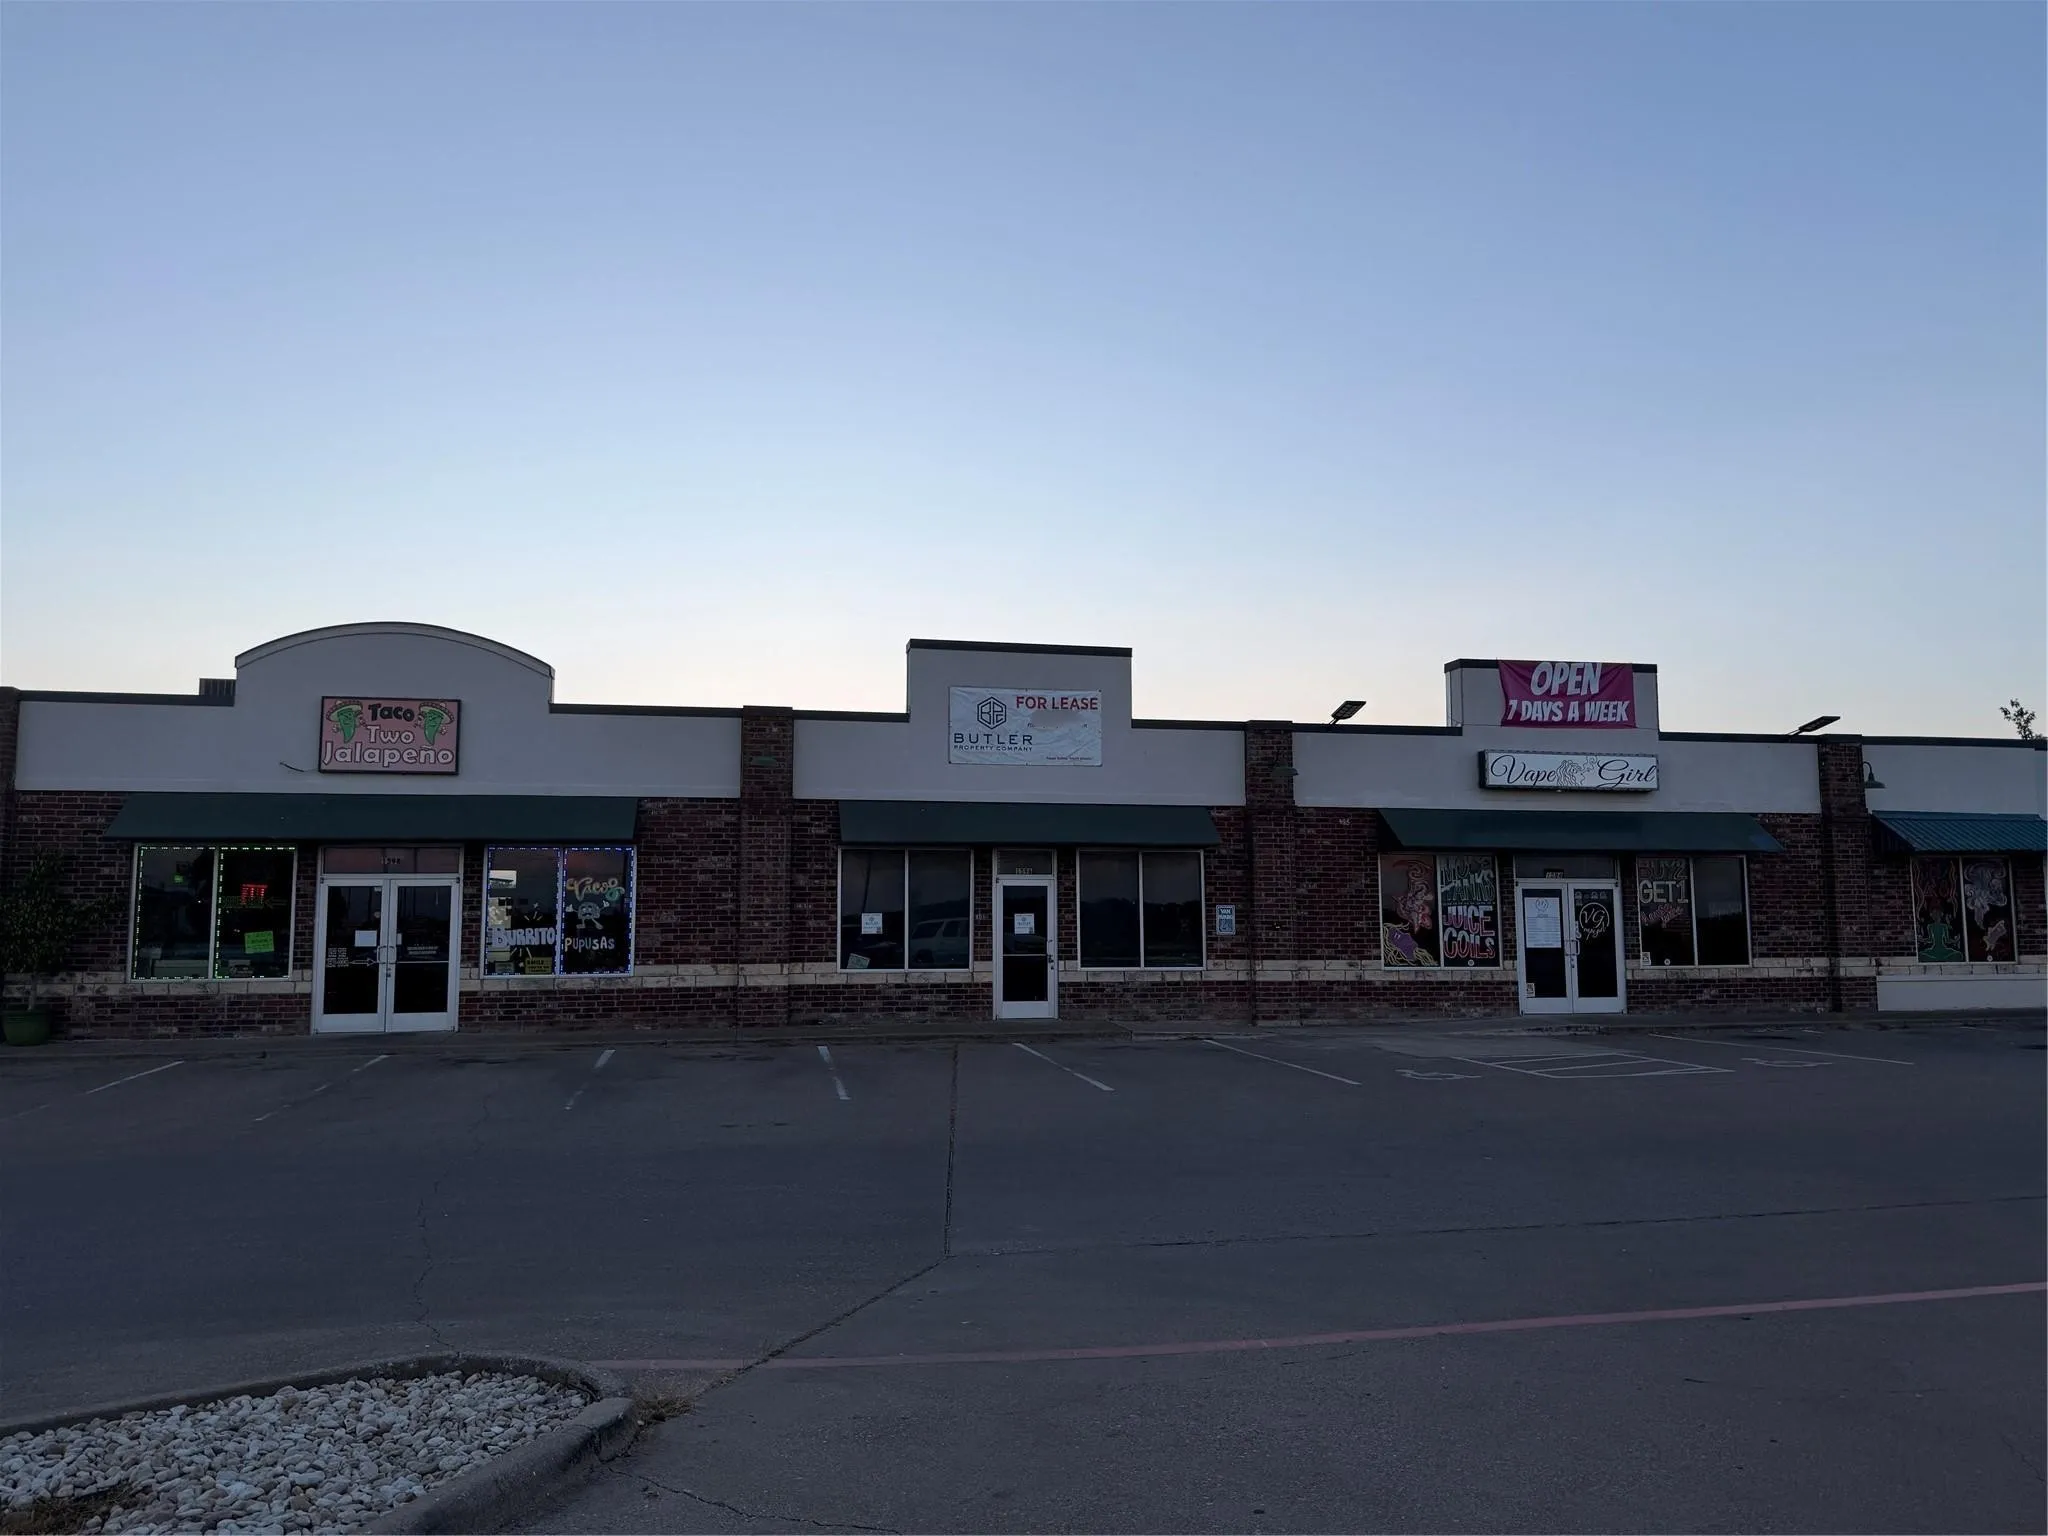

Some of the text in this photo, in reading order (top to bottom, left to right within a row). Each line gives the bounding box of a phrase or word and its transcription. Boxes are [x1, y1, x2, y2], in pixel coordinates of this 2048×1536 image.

[1531, 661, 1602, 696] OPEN
[368, 703, 415, 722] Taco
[1016, 696, 1098, 710] FOR LEASE
[1507, 700, 1630, 722] 7 DAYS A WEEK
[367, 725, 415, 744] Two
[954, 733, 1033, 745] BUTLER
[322, 741, 455, 767] Jalapeño
[1490, 754, 1657, 789] Vape Girl
[1639, 880, 1690, 904] GET 1
[1443, 904, 1496, 937] JUICE
[1443, 927, 1496, 959] COILS
